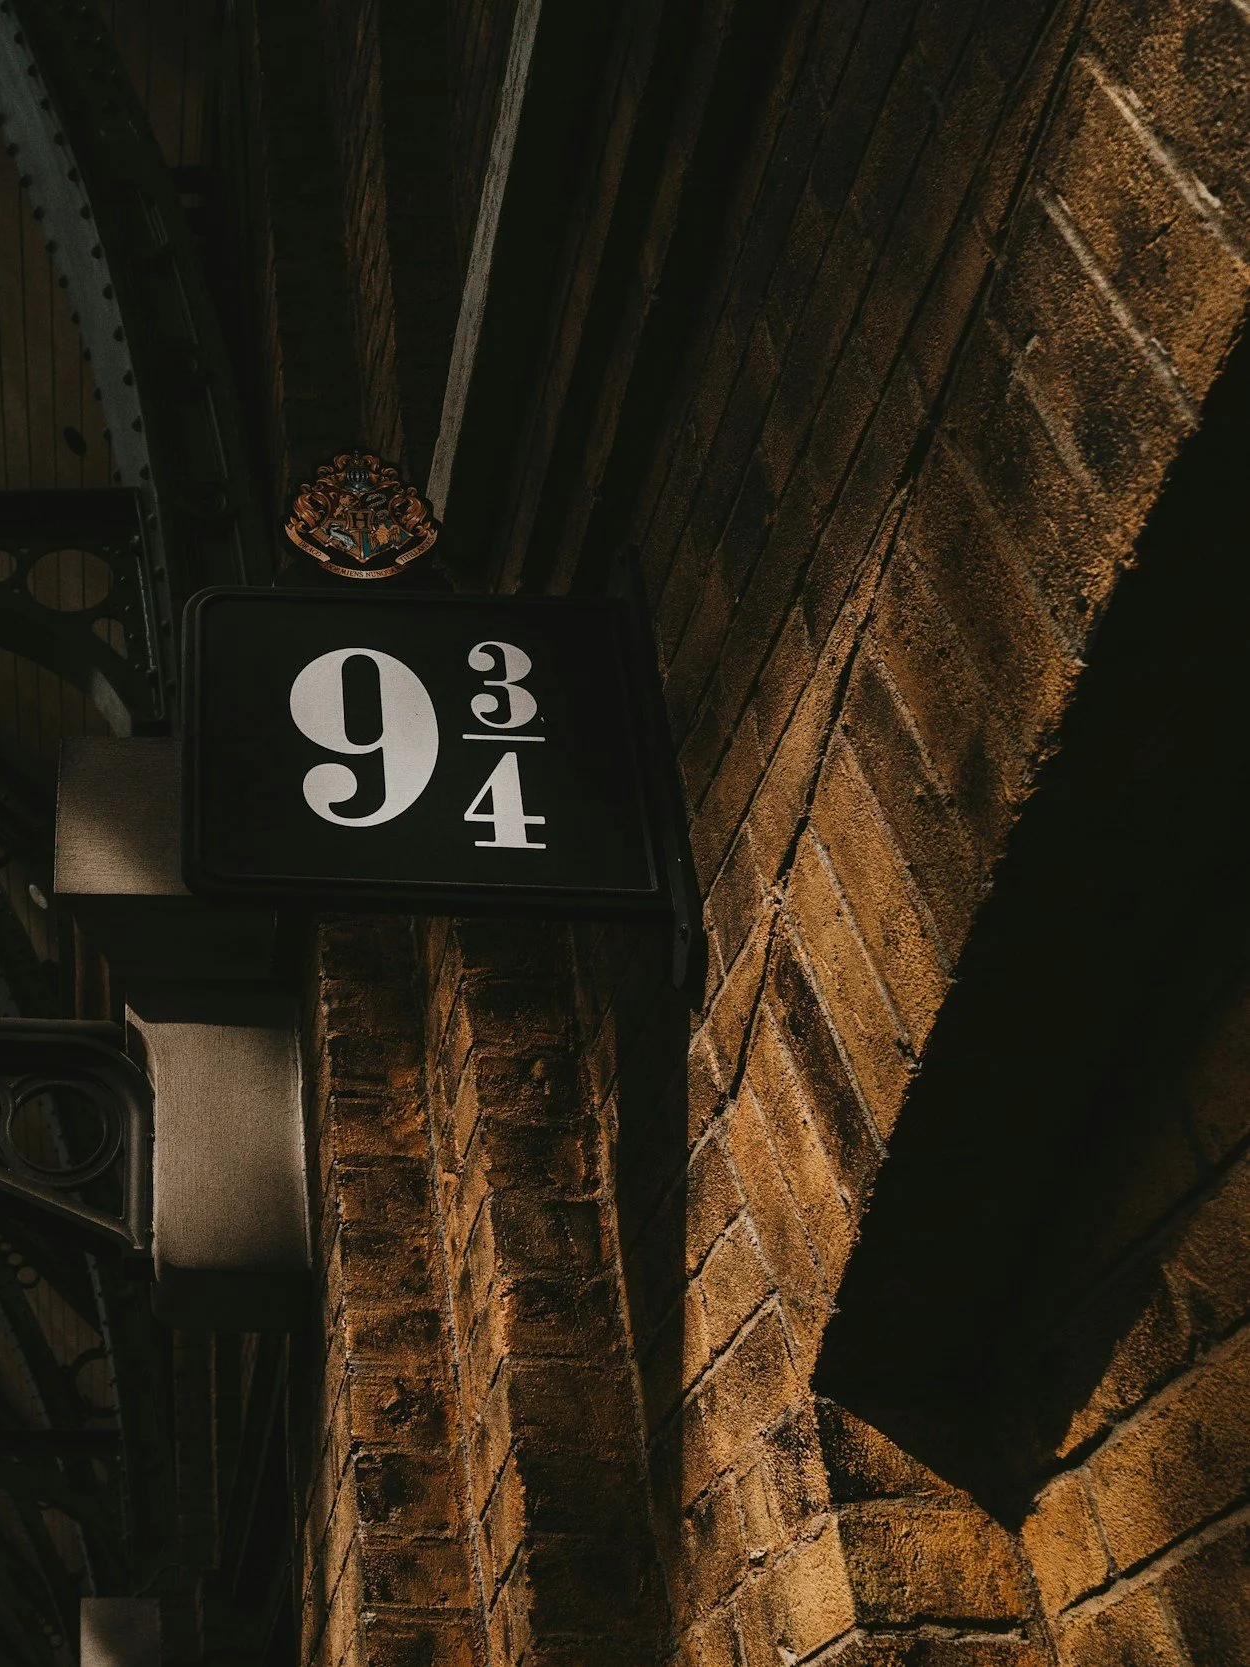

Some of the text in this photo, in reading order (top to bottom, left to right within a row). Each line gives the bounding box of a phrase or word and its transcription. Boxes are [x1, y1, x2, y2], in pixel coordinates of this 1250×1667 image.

[350, 512, 370, 529] H
[298, 541, 322, 557] DRACO
[290, 647, 440, 828] 9
